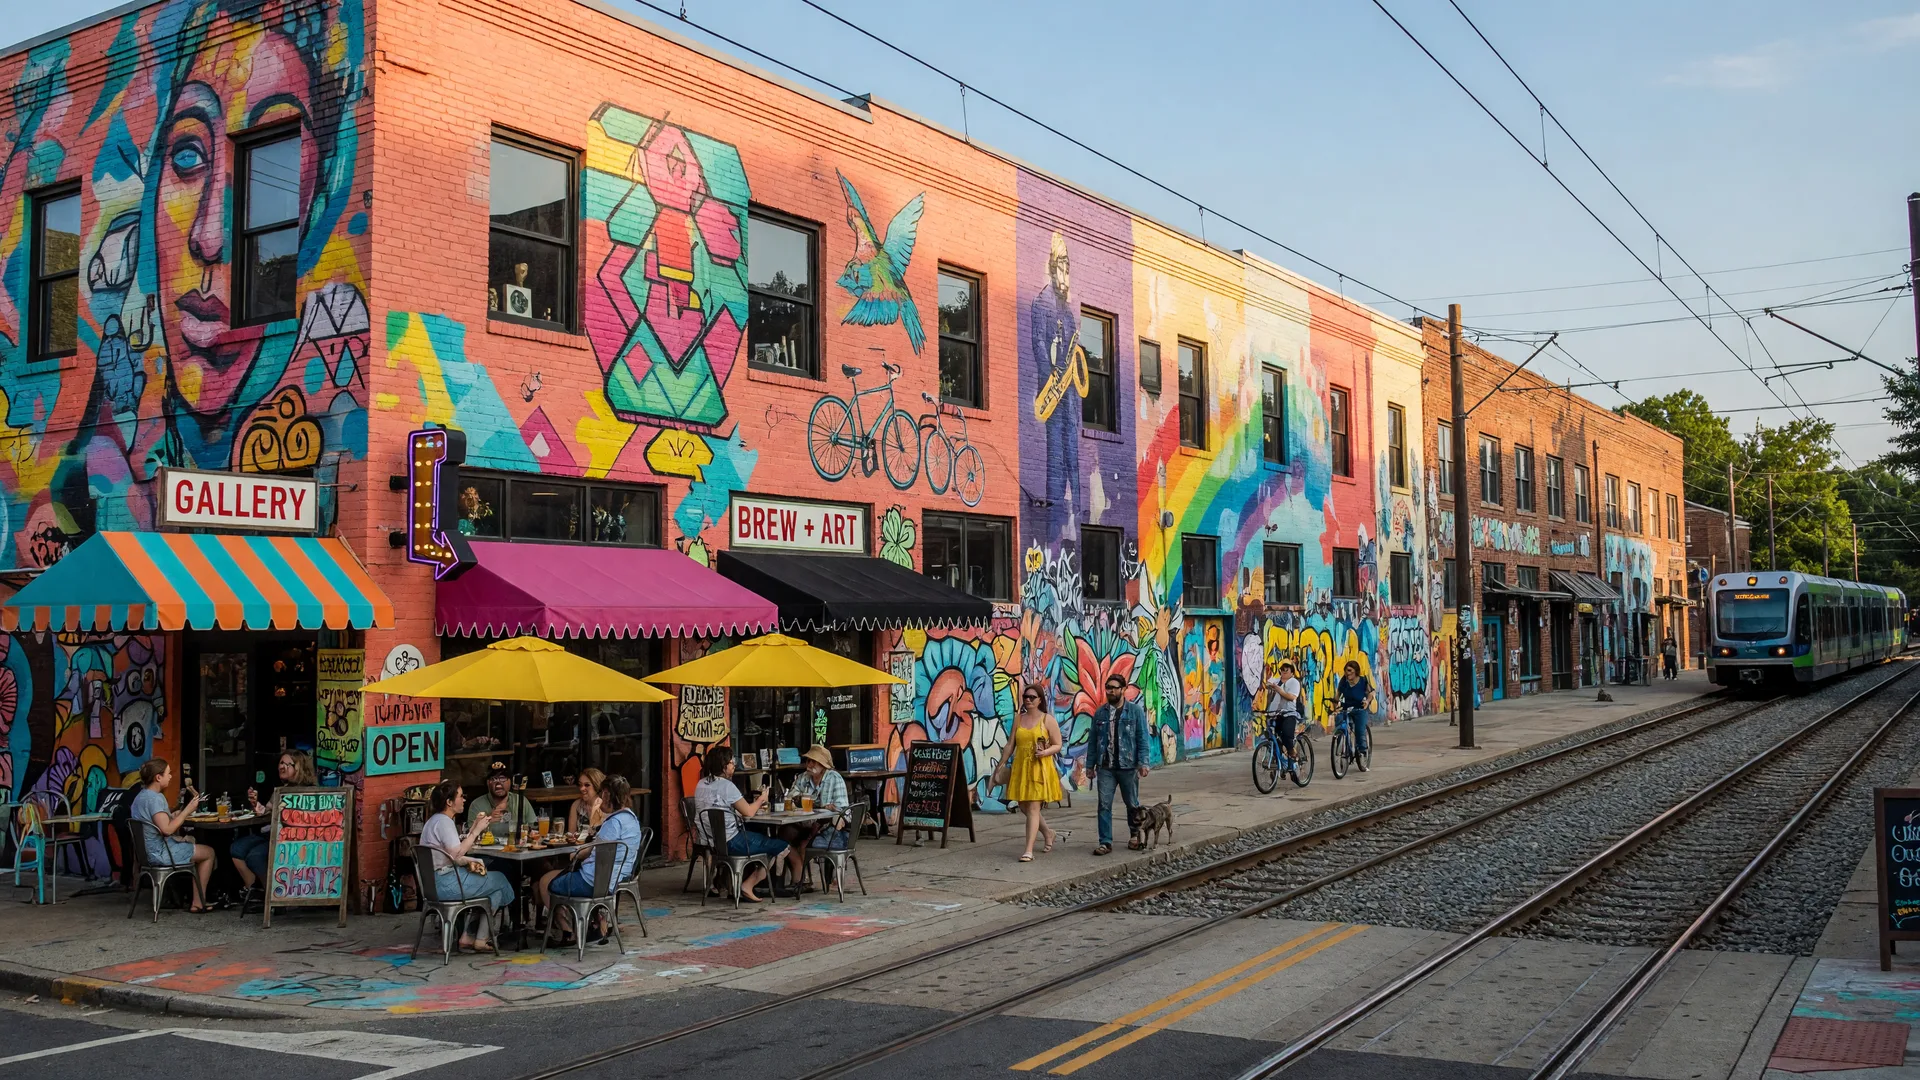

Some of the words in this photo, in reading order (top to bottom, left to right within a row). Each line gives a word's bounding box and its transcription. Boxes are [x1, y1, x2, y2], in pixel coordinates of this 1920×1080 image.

[175, 479, 307, 521] GALLERY
[738, 505, 798, 542] BREW
[820, 513, 857, 546] ART
[372, 730, 440, 767] OPEN
